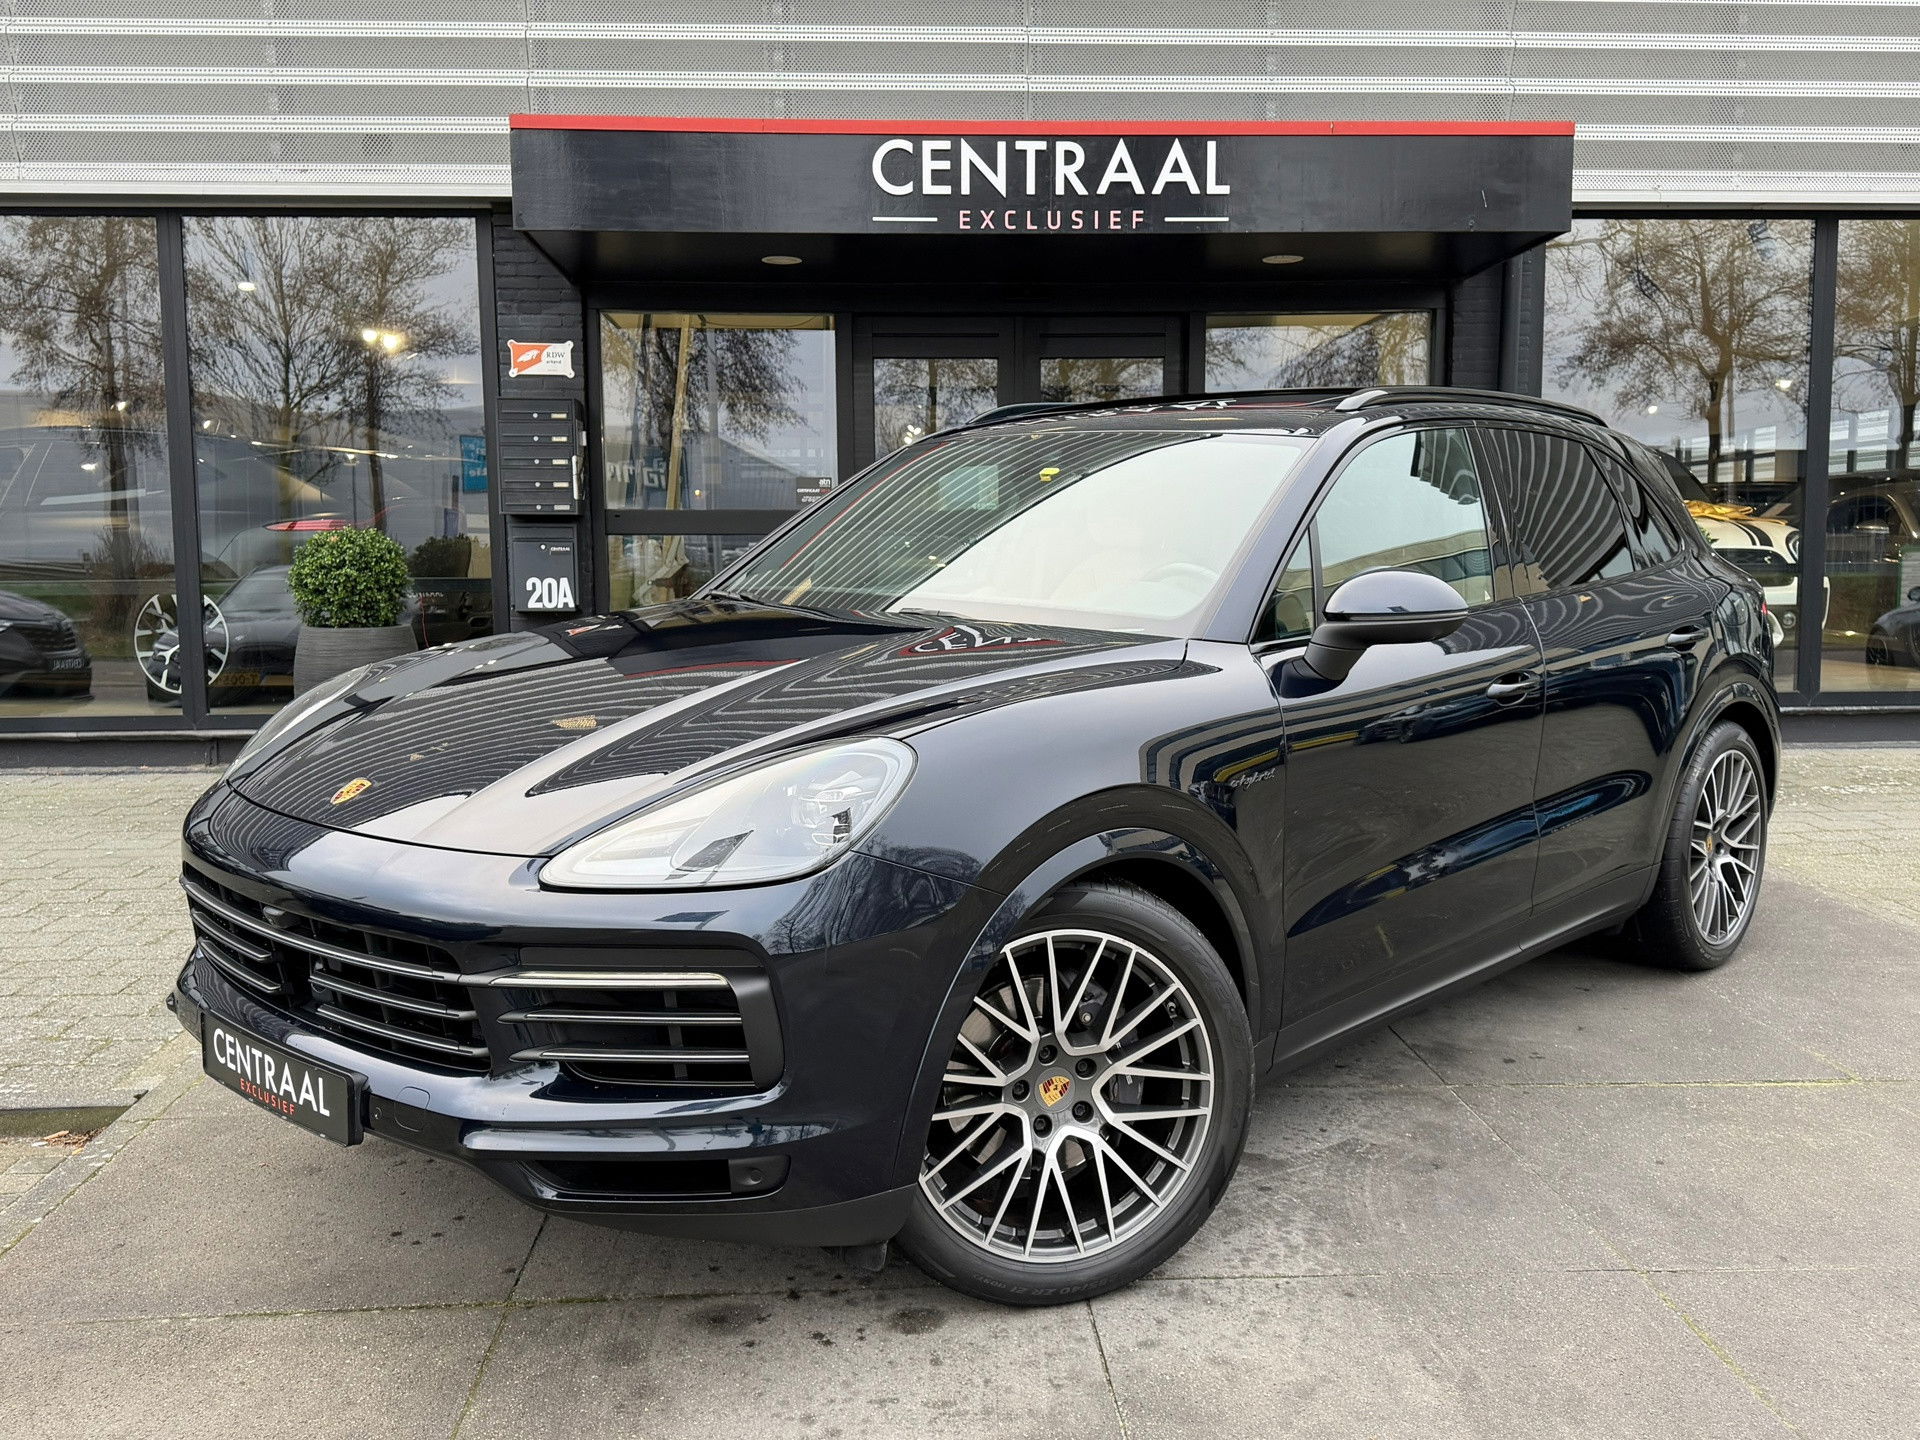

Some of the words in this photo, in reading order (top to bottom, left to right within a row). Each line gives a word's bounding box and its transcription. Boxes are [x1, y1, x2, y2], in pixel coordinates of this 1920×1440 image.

[872, 138, 1231, 198] CENTRAAL
[959, 210, 1145, 230] EXCLUSIEF
[526, 577, 575, 609] 20A
[213, 1028, 331, 1118] CENTRAAL
[239, 1077, 296, 1117] EXCLUSIEF
